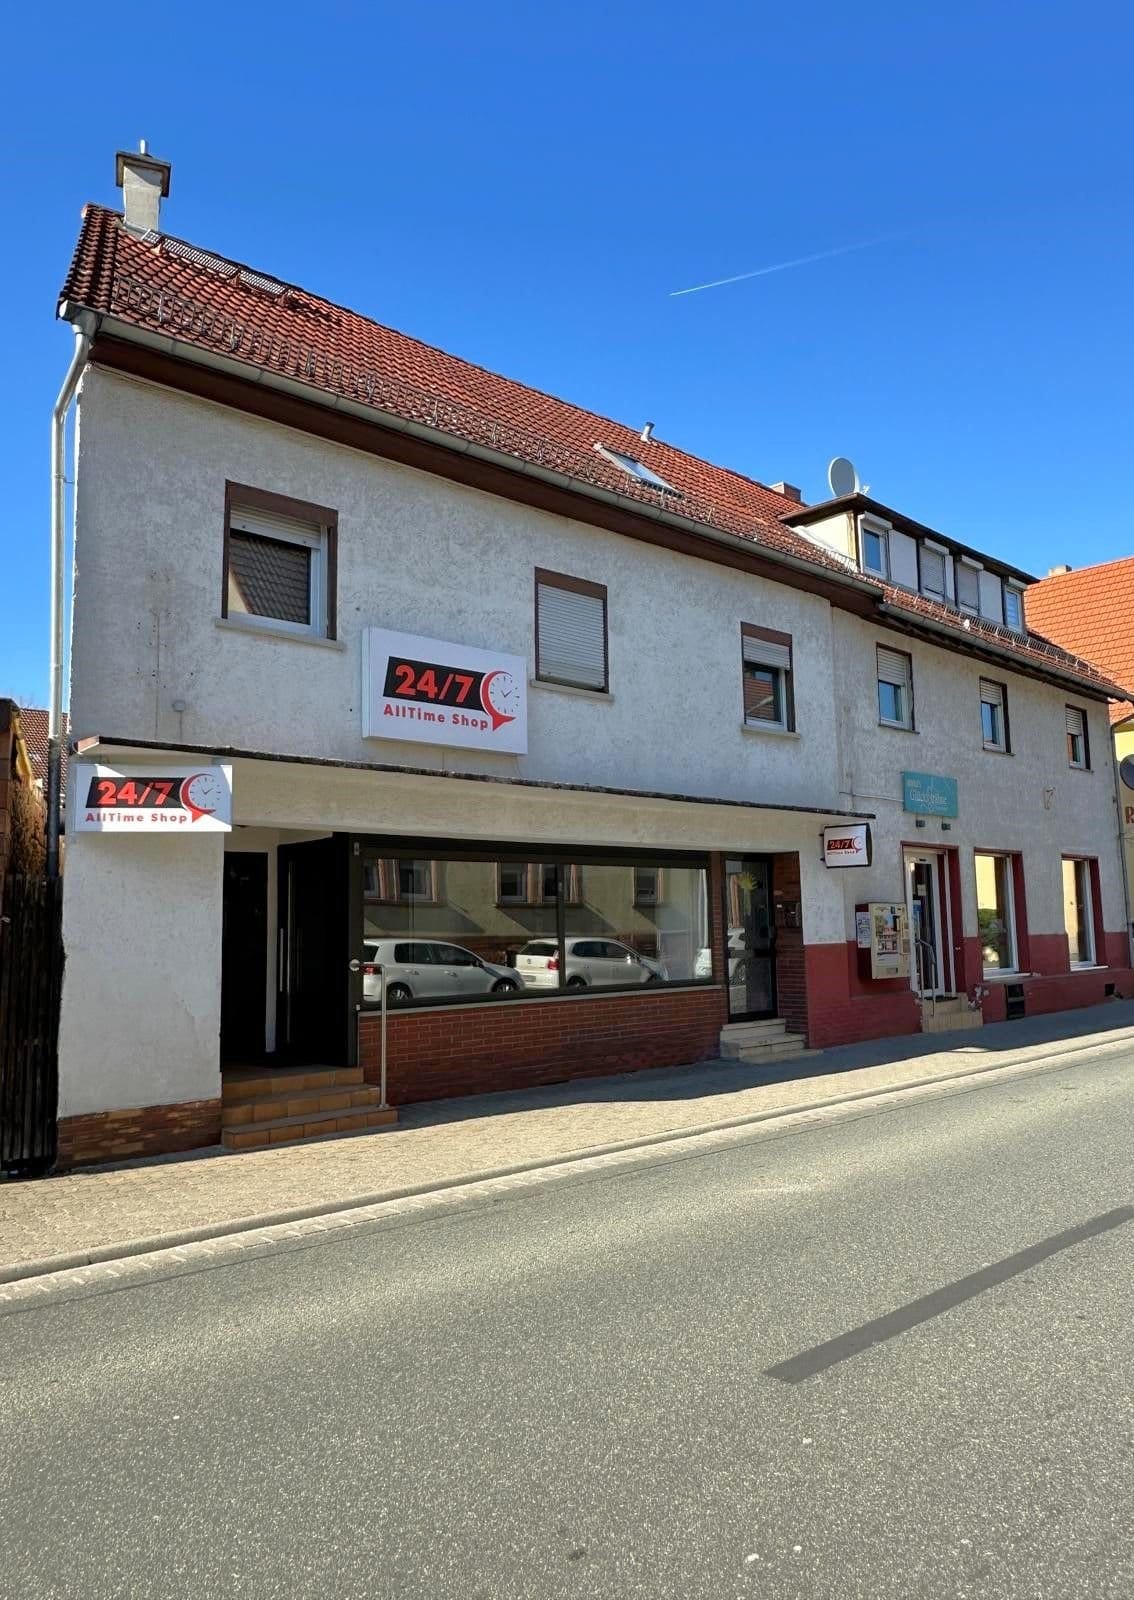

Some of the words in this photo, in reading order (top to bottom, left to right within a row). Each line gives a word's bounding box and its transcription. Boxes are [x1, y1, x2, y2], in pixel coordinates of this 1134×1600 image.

[395, 664, 474, 703] 24/7
[383, 703, 445, 723] AllTime
[452, 713, 489, 731] Shop
[97, 779, 175, 805] 24/7
[85, 812, 145, 822] AllTime
[151, 812, 188, 824] Shop
